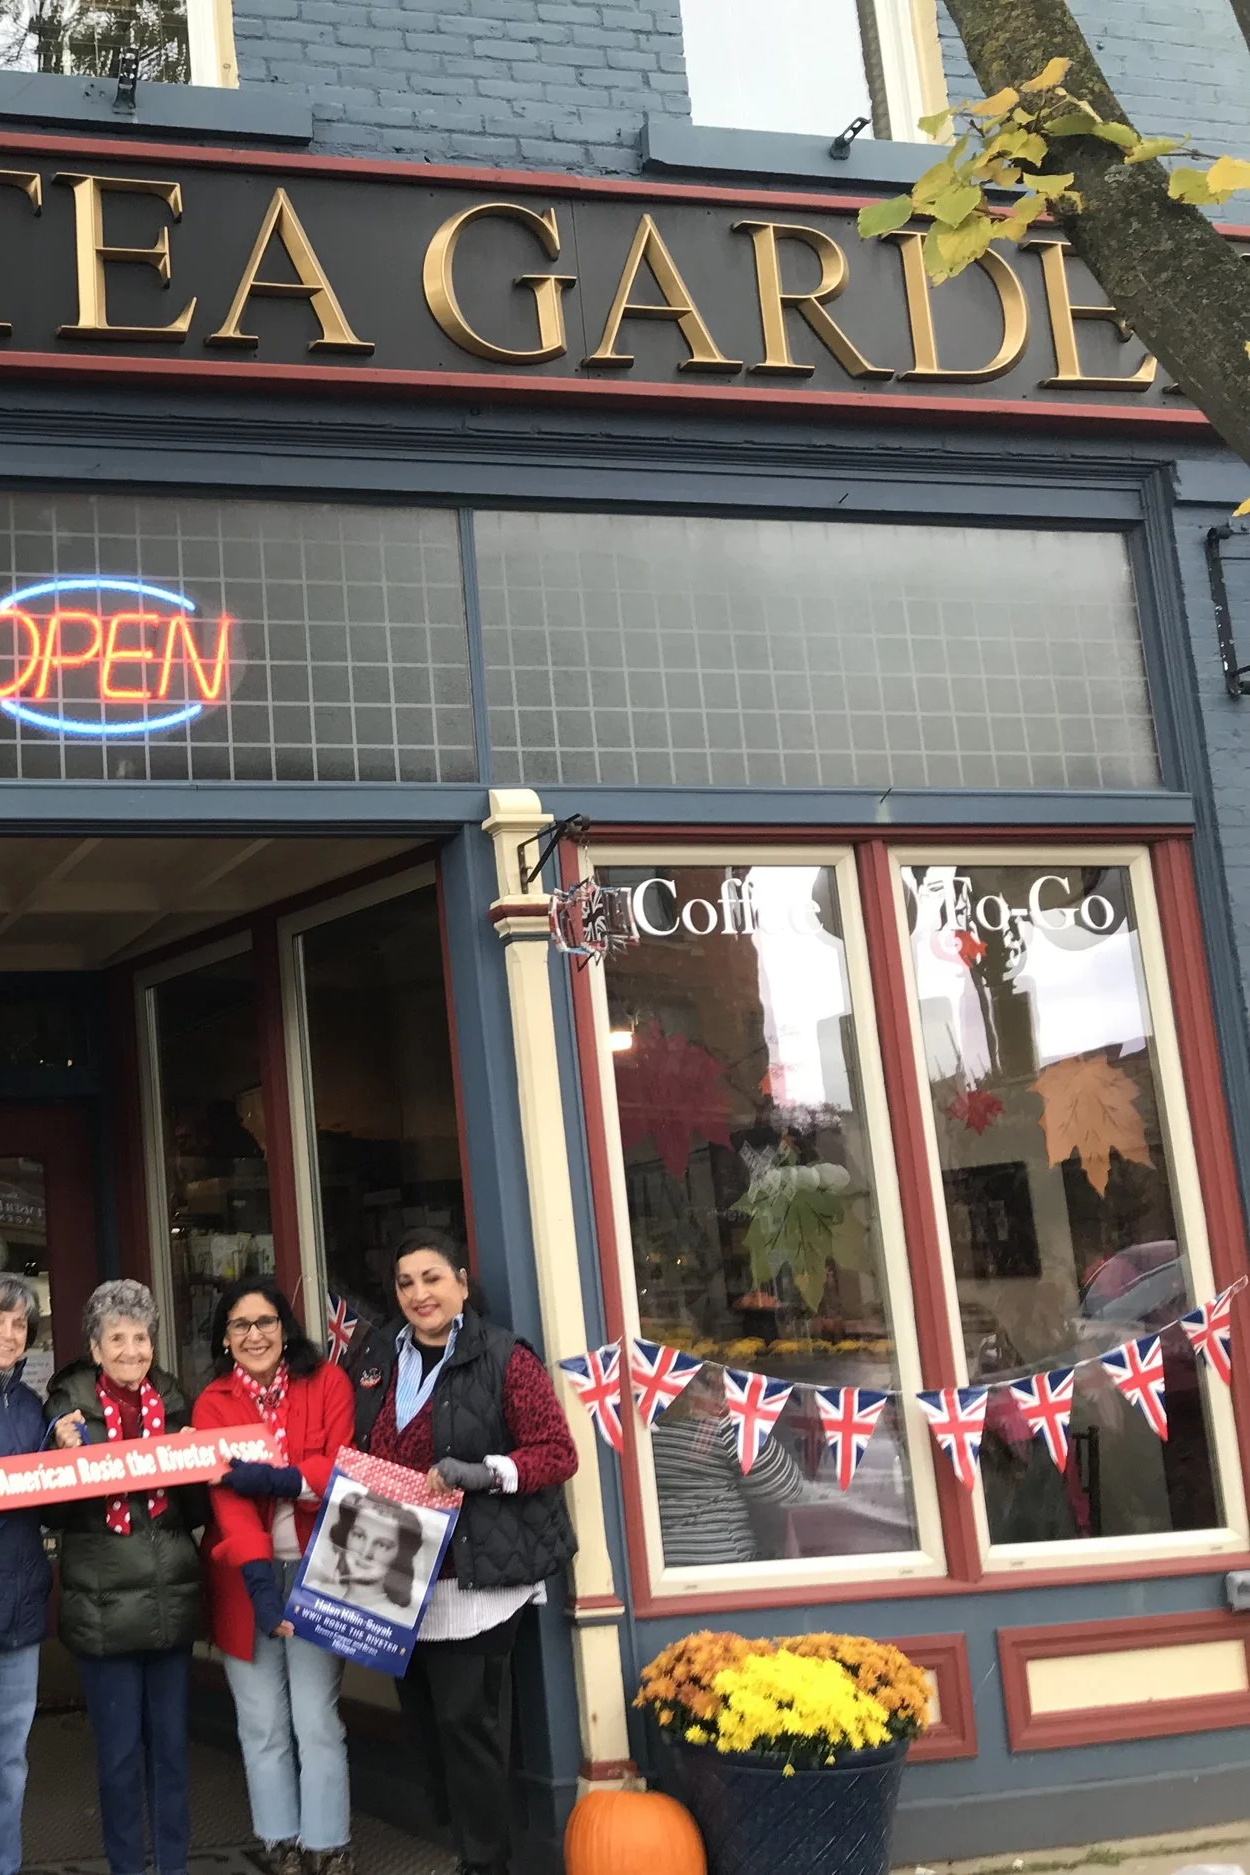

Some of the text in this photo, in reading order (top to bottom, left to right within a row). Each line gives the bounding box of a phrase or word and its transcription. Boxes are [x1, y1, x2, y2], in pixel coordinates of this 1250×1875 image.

[422, 200, 1190, 393] GARDE
[77, 1453, 126, 1484] Rosie
[125, 1449, 157, 1478] the
[156, 1443, 217, 1473] Riveter
[314, 1598, 341, 1618] Helen
[349, 1626, 365, 1640] THE
[365, 1633, 399, 1653] RIVETER
